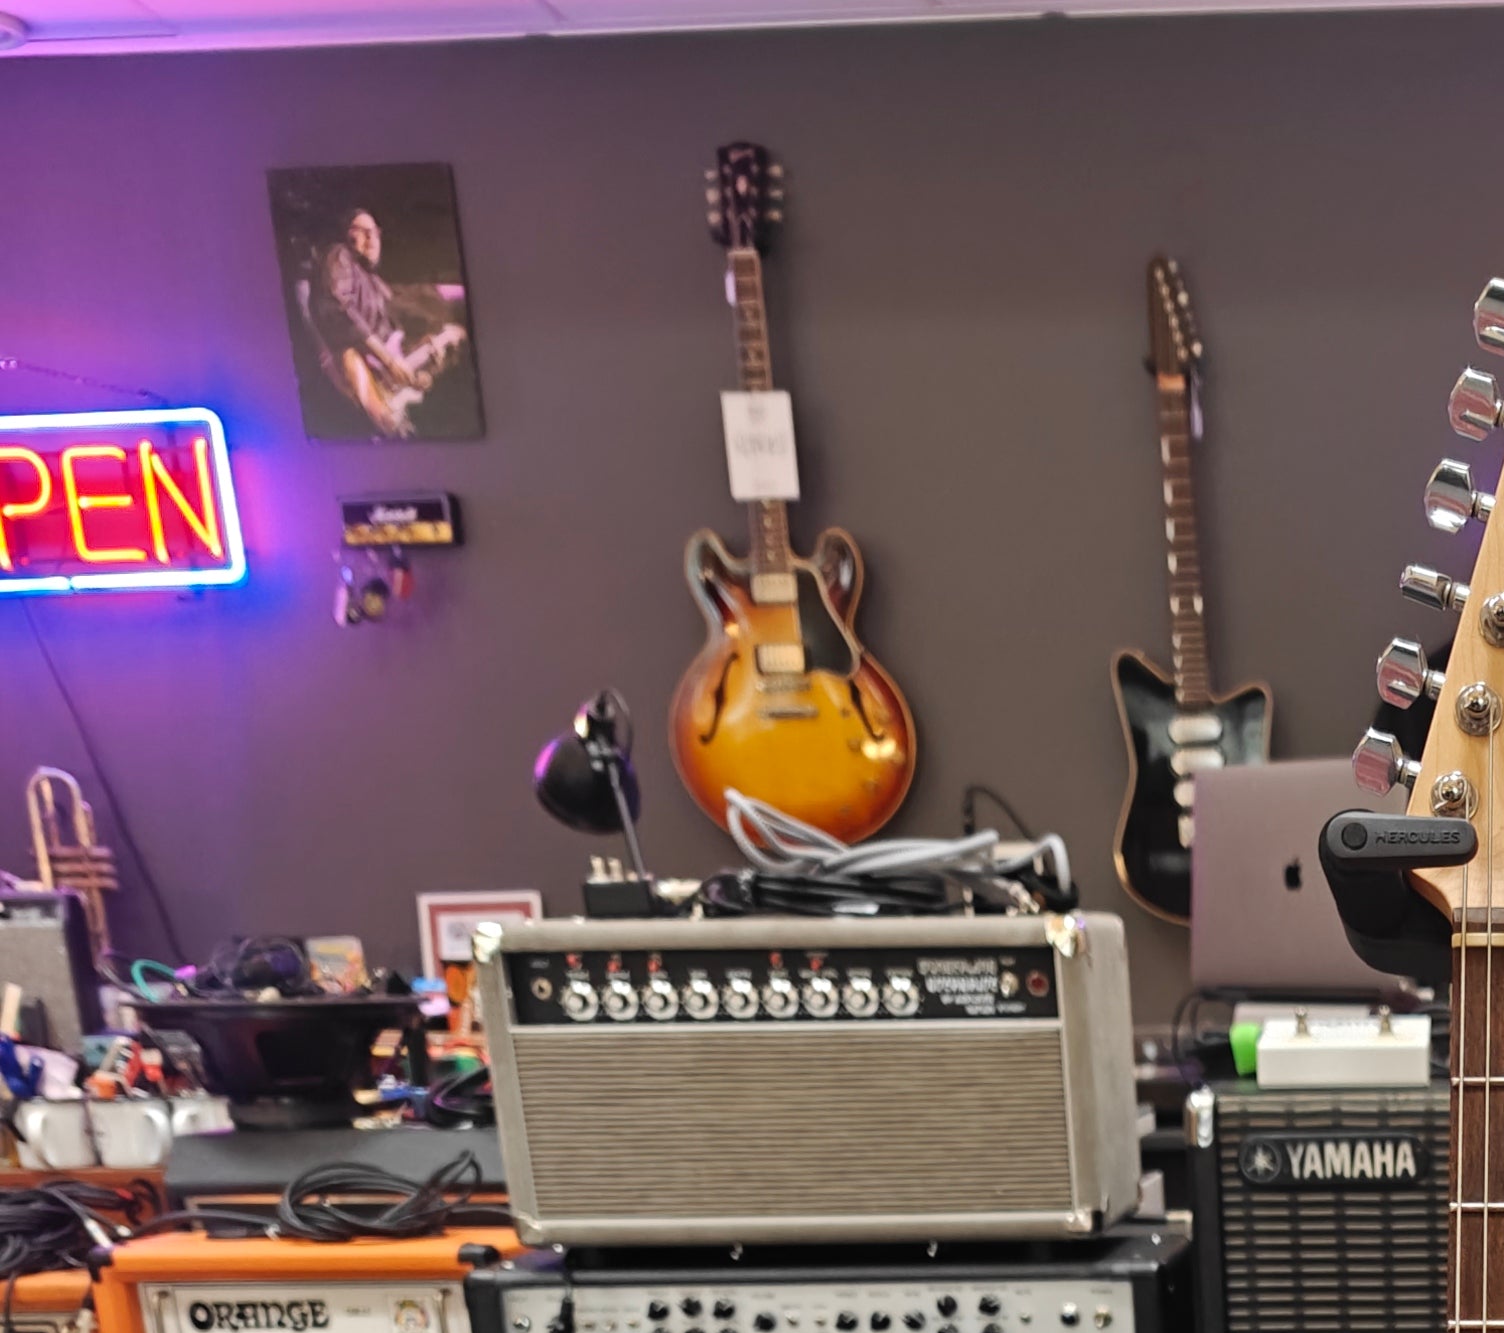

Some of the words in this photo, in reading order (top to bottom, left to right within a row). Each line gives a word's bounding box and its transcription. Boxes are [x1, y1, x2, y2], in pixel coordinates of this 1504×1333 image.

[0, 436, 224, 572] PEN
[1375, 830, 1461, 845] HERCULES
[1287, 1141, 1417, 1180] YAMAHA
[189, 1299, 330, 1332] ORANGE
